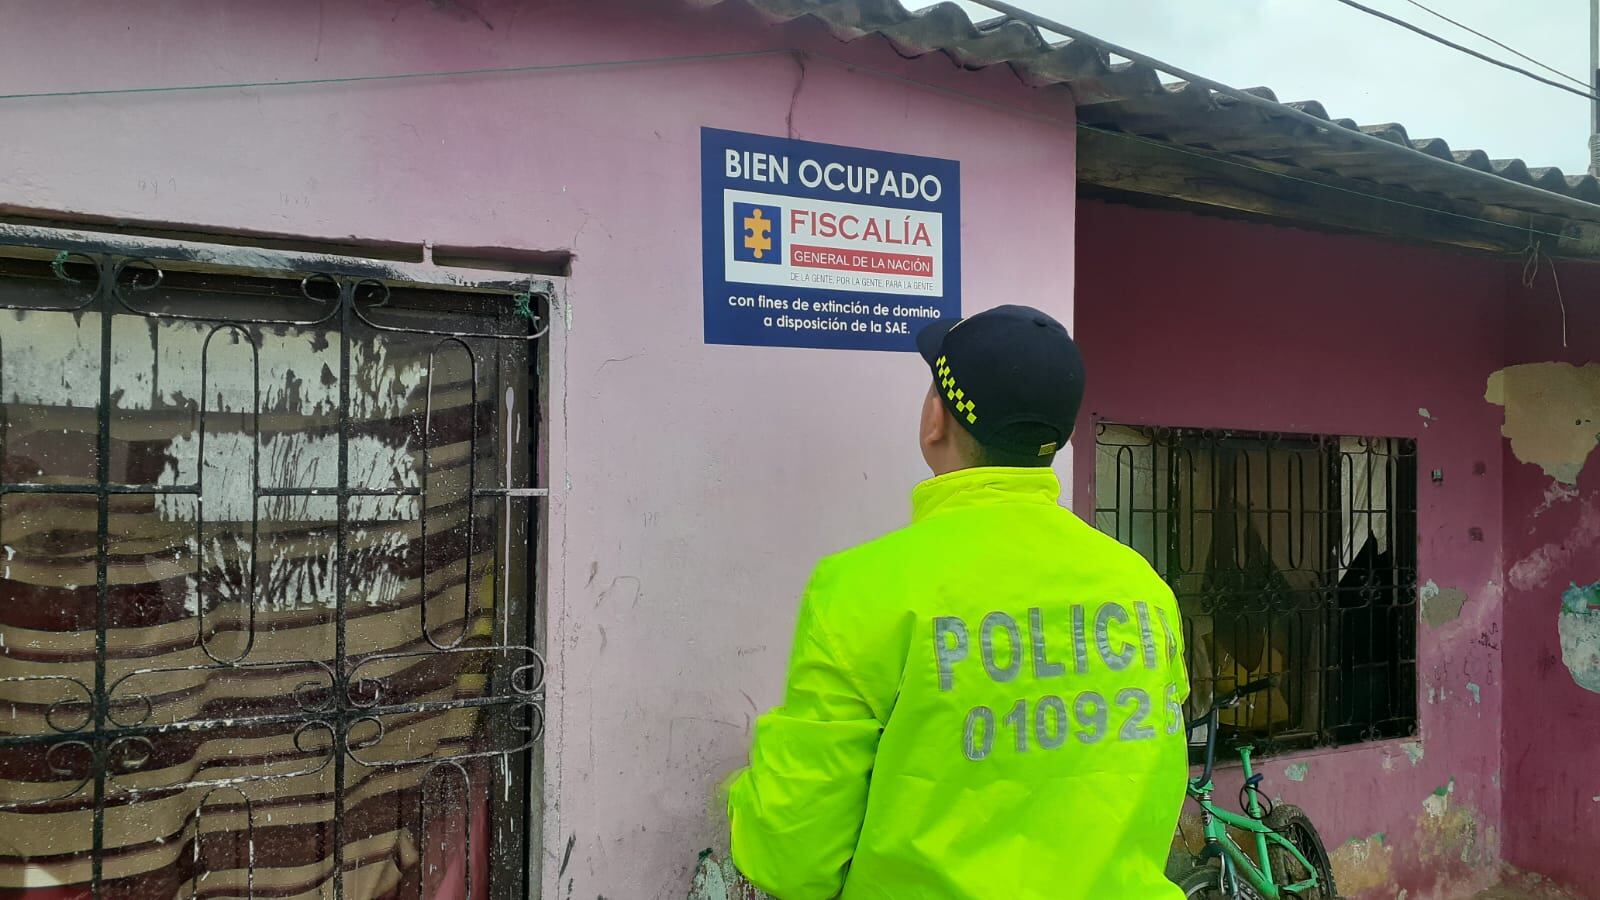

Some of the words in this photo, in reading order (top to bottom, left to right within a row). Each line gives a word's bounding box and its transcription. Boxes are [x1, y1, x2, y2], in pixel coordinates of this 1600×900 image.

[725, 149, 789, 185] BIEN
[799, 159, 942, 202] OCUPADO
[790, 209, 932, 246] FISCALÍA
[794, 250, 850, 266] GENERAL
[853, 256, 868, 267] DE
[871, 257, 885, 269] LA
[887, 256, 930, 272] NACIÓN
[791, 272, 800, 281] DE
[801, 273, 809, 281] LA
[836, 276, 850, 285] POR
[852, 277, 860, 285] LA
[886, 280, 902, 288] PARA
[728, 296, 754, 307] con
[758, 295, 788, 309] fines
[792, 298, 809, 311] de
[813, 300, 869, 314] extinción
[873, 304, 889, 316] de
[893, 305, 941, 319] dominio
[764, 316, 773, 327] a
[776, 316, 848, 330] disposición
[851, 320, 867, 332] de
[870, 321, 882, 333] la
[885, 322, 910, 334] SAE.
